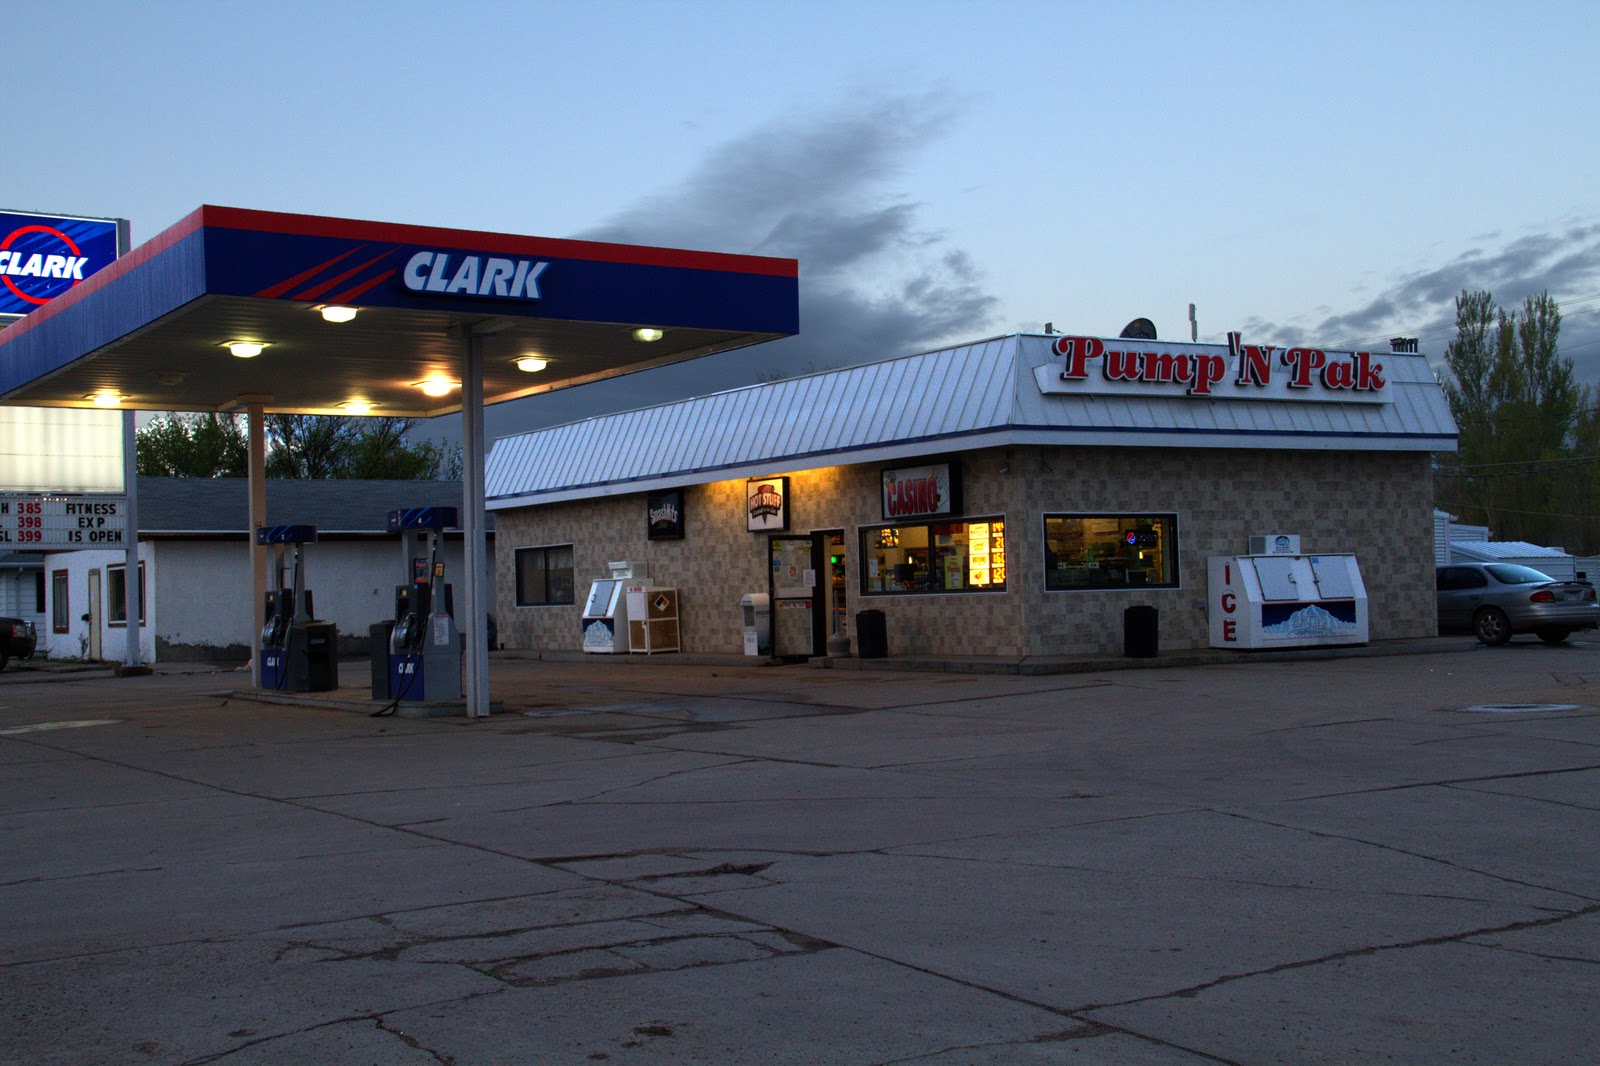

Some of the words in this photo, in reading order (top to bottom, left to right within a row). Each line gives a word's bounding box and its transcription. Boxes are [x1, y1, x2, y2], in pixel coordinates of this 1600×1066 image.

[0, 250, 89, 280] CLARK
[403, 250, 550, 299] CLARK
[1052, 336, 1227, 396] Pump
[1281, 346, 1386, 391] Pak
[750, 494, 762, 511] HOT
[762, 492, 781, 510] STUFF
[887, 476, 939, 516] CASINO
[17, 502, 42, 514] 385
[66, 503, 117, 515] FITNESS
[17, 516, 42, 528] 398
[17, 530, 42, 542] 399
[68, 530, 82, 542] IS
[89, 530, 122, 542] OPEN
[1221, 561, 1237, 642] ICE
